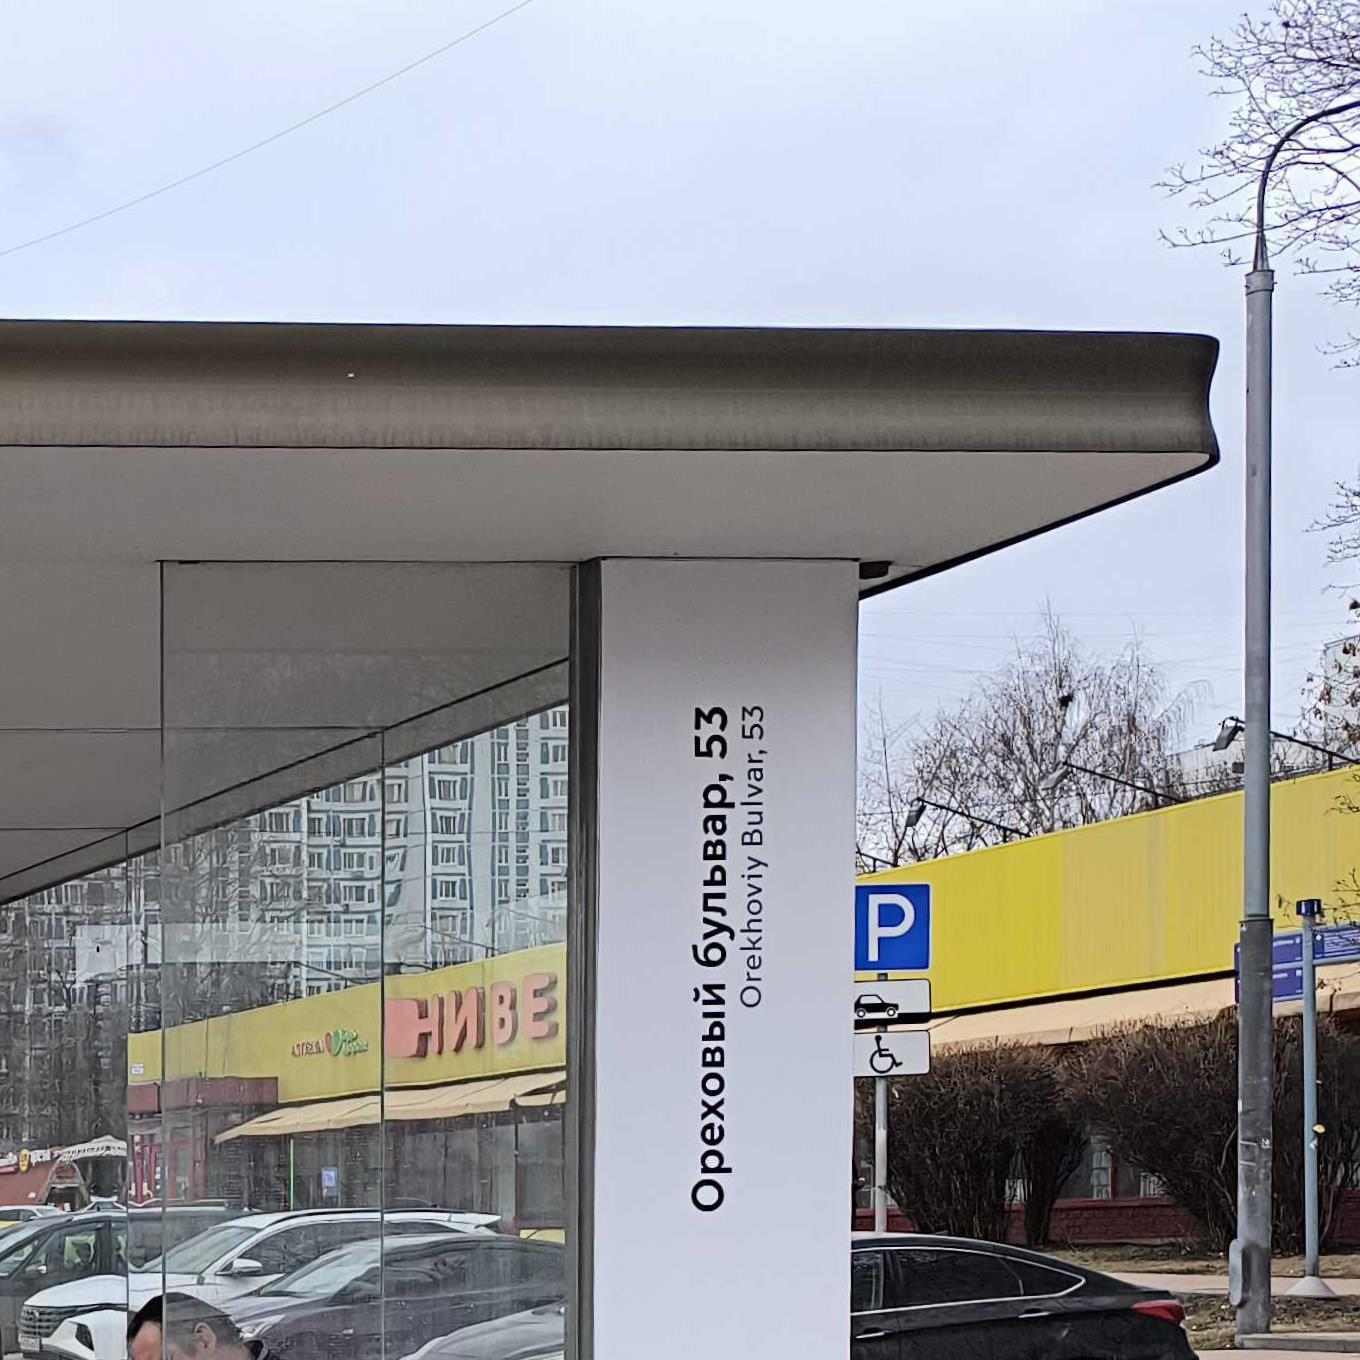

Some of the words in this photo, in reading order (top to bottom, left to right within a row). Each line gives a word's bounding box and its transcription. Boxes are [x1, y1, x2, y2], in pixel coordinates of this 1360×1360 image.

[694, 706, 729, 760] 53
[741, 705, 765, 741] 53
[739, 749, 769, 847] Bulvar,
[691, 773, 736, 968] бульвар,
[739, 855, 769, 1008] Orekhoviy
[690, 983, 733, 1212] Ореховый
